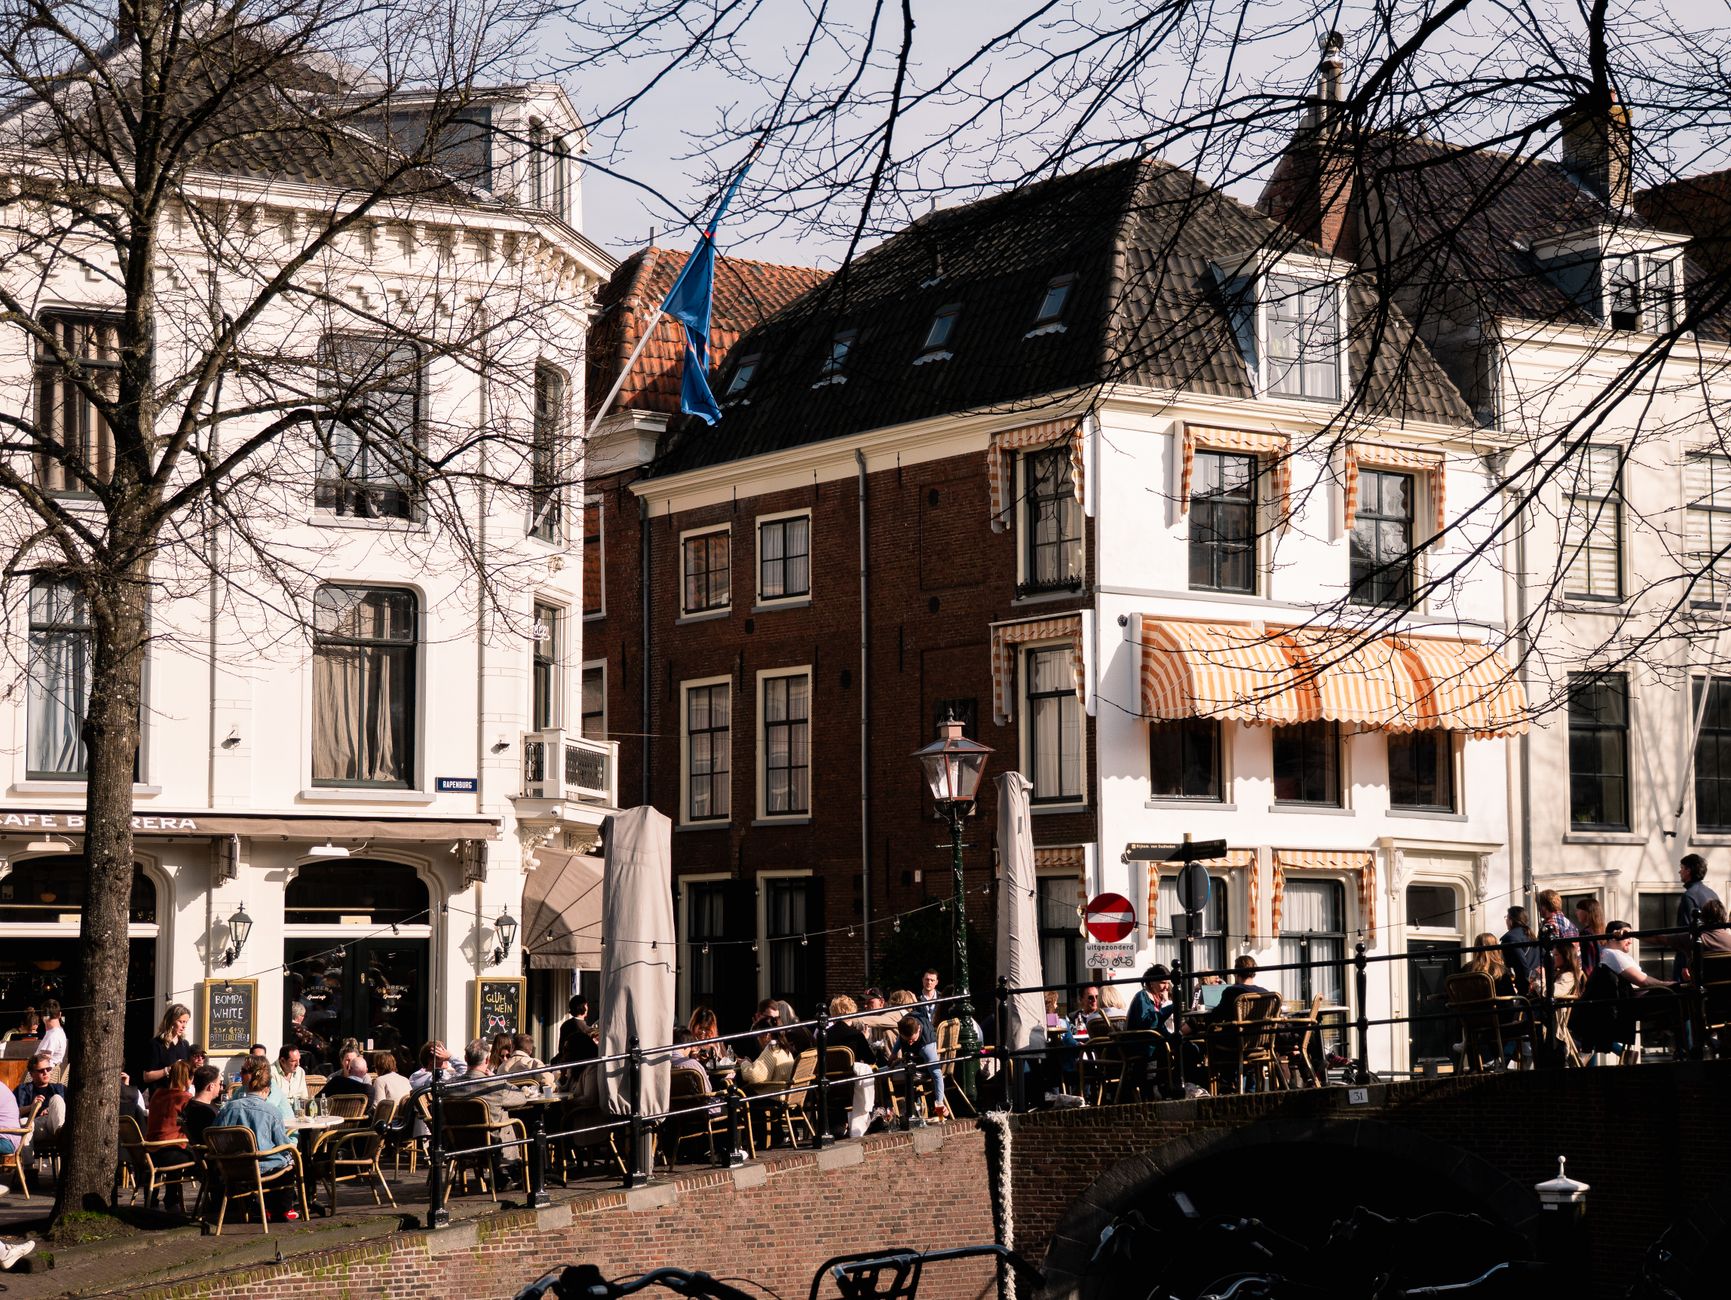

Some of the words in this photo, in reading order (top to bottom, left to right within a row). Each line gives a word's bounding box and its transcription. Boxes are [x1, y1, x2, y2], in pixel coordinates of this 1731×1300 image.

[443, 781, 472, 789] RAPENBURG
[0, 814, 57, 827] AFE
[215, 994, 243, 1005] BOMPA
[486, 992, 506, 1003] GLÜH
[213, 1007, 244, 1019] WHITE
[495, 1003, 513, 1014] WEIN
[1353, 1091, 1363, 1101] 31
